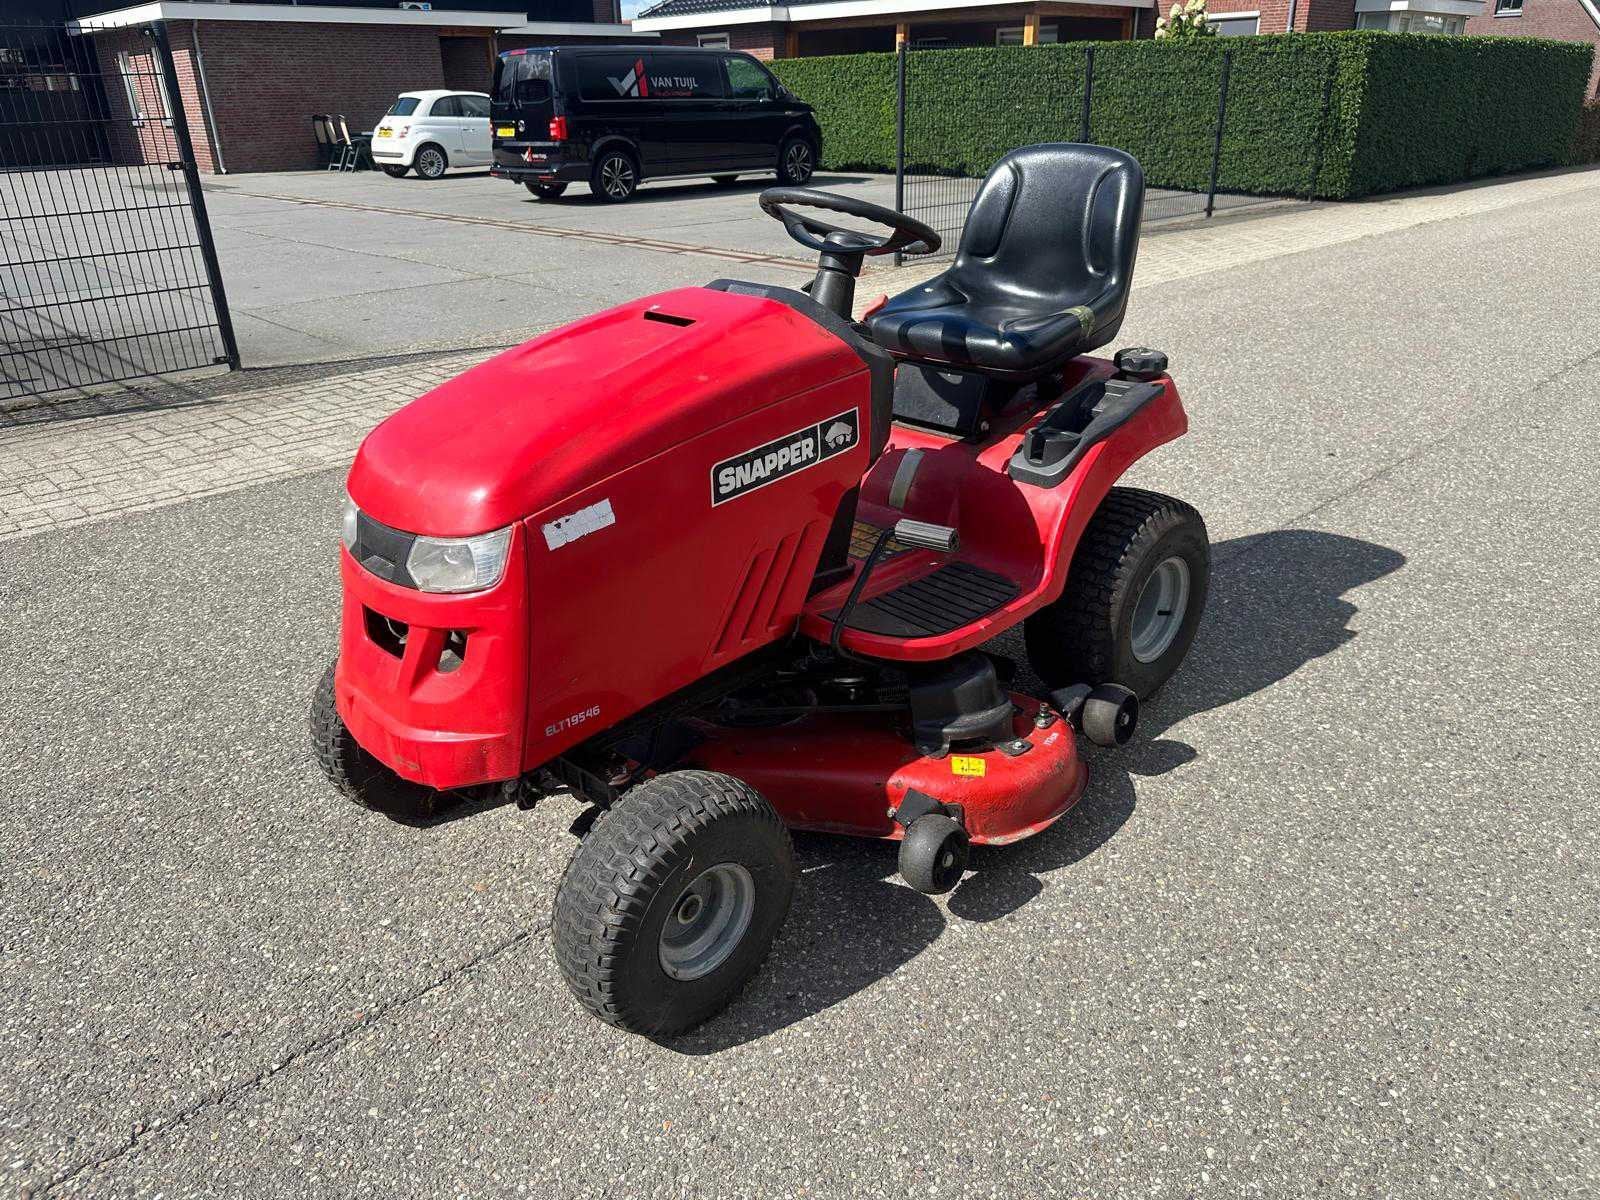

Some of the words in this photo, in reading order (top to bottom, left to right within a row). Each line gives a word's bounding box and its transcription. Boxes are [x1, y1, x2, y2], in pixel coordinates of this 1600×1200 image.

[650, 76, 673, 88] VAN
[674, 76, 699, 90] TUIJL
[718, 437, 815, 495] SNAPPER
[545, 704, 601, 737] ELT19546
